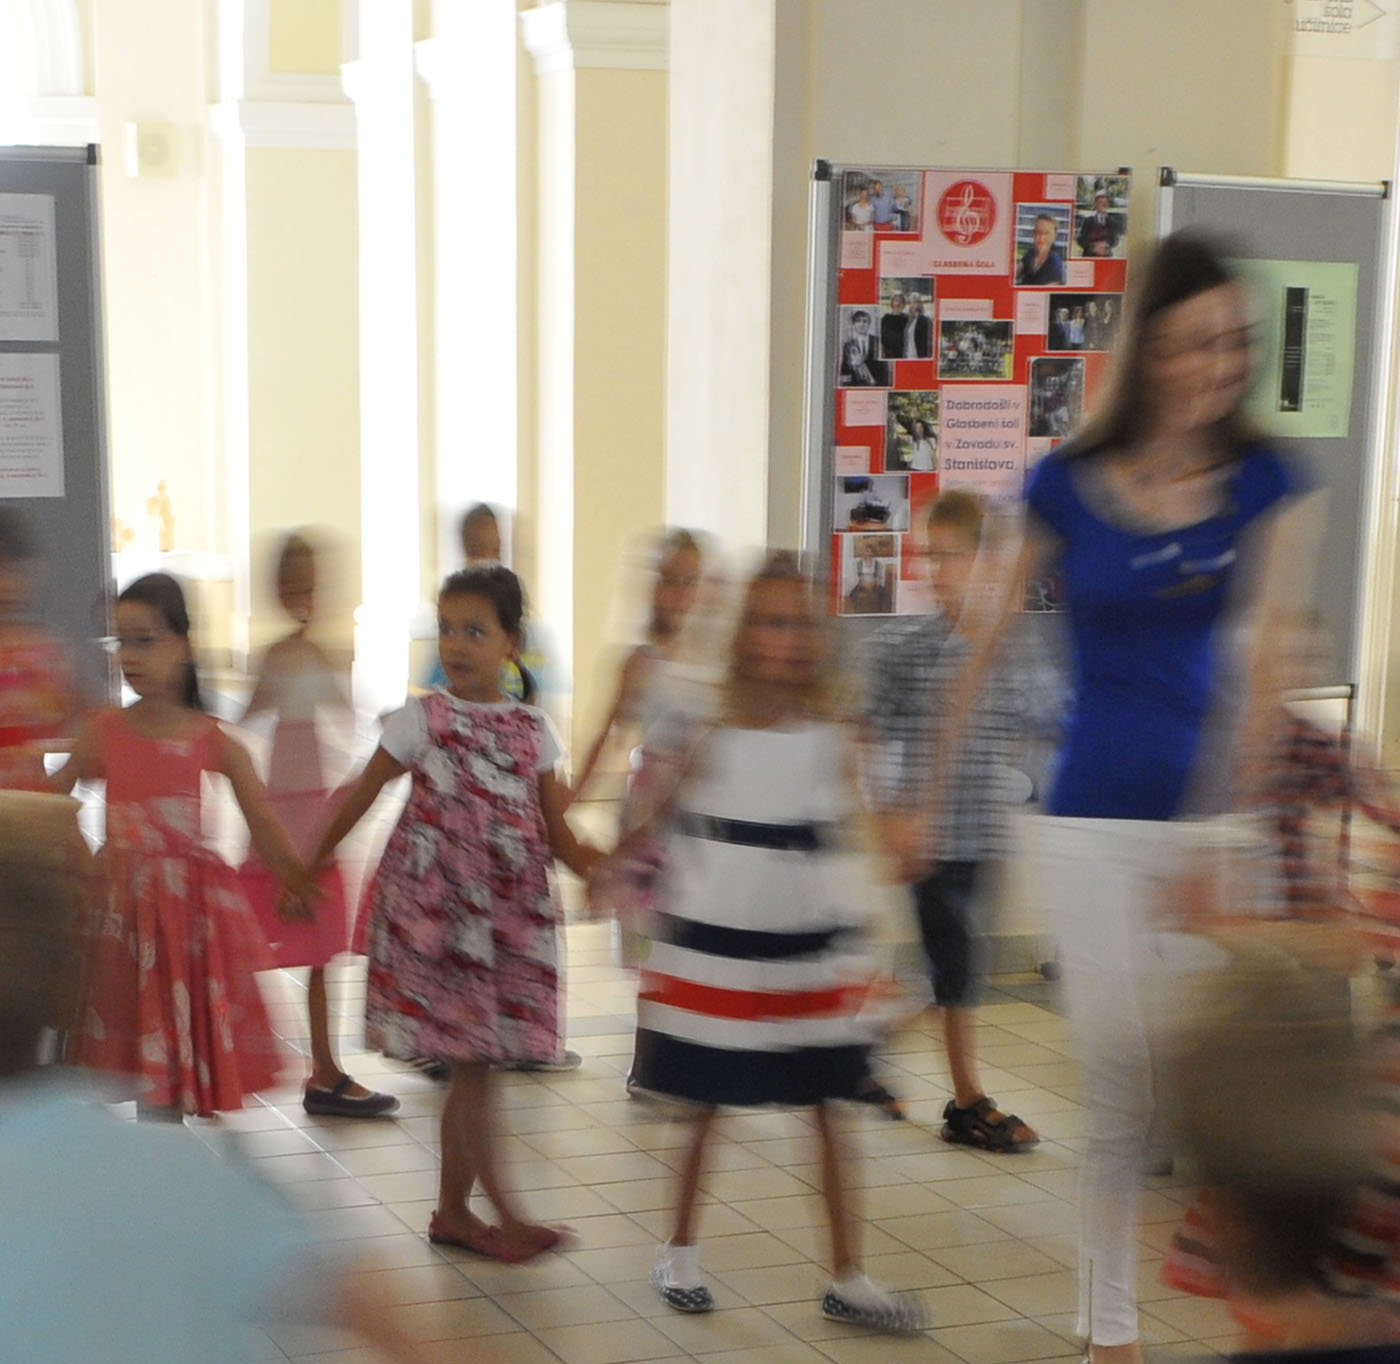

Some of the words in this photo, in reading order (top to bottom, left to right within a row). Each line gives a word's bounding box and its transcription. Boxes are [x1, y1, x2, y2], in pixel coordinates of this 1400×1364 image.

[947, 399, 1011, 410] Dobrodošli
[947, 418, 998, 429] Glasbeni
[956, 439, 1000, 449] Zavodu
